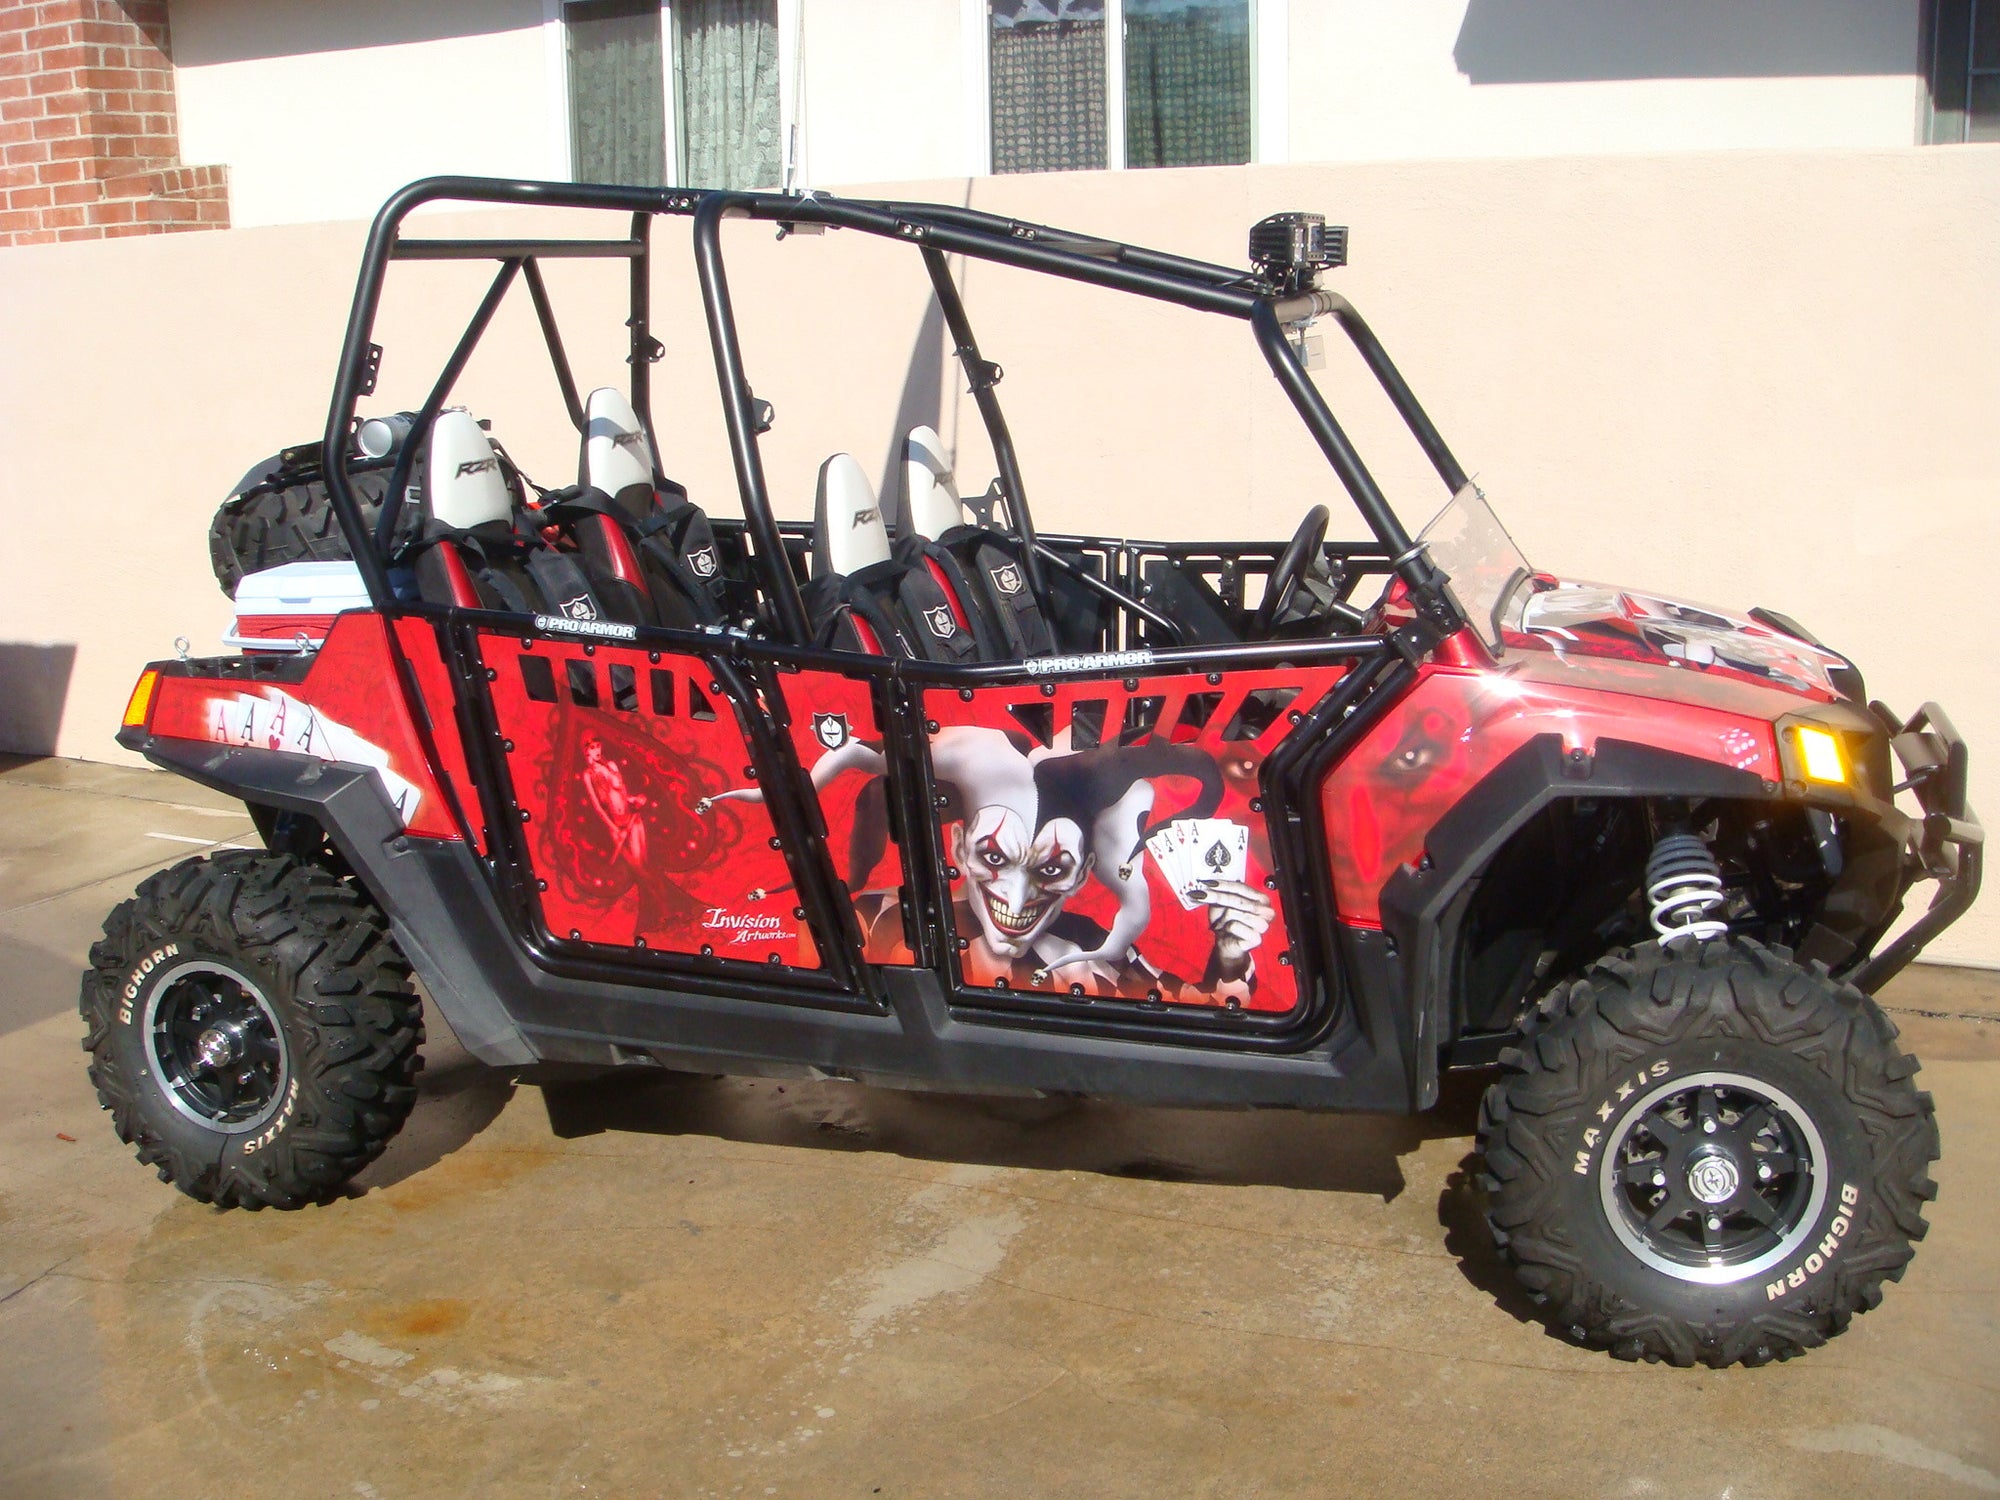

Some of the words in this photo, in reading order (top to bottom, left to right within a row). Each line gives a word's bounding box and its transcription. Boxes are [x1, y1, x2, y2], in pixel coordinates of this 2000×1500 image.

[454, 457, 497, 480] RZR
[548, 617, 579, 632] PRO
[579, 620, 634, 638] ARMOR
[1041, 657, 1080, 672] PRO
[1083, 651, 1150, 669] ARMOR
[215, 704, 229, 743] A
[240, 702, 254, 742] A
[269, 696, 286, 736] A
[297, 715, 314, 753] A
[1191, 821, 1200, 836] A
[1238, 828, 1246, 844] A
[702, 907, 781, 929] Invision
[119, 943, 180, 1025] BIGHORN
[243, 1077, 300, 1155] MAXXIS
[1573, 1060, 1670, 1176] MAXXIS
[1765, 1183, 1858, 1301] BIGHORN
